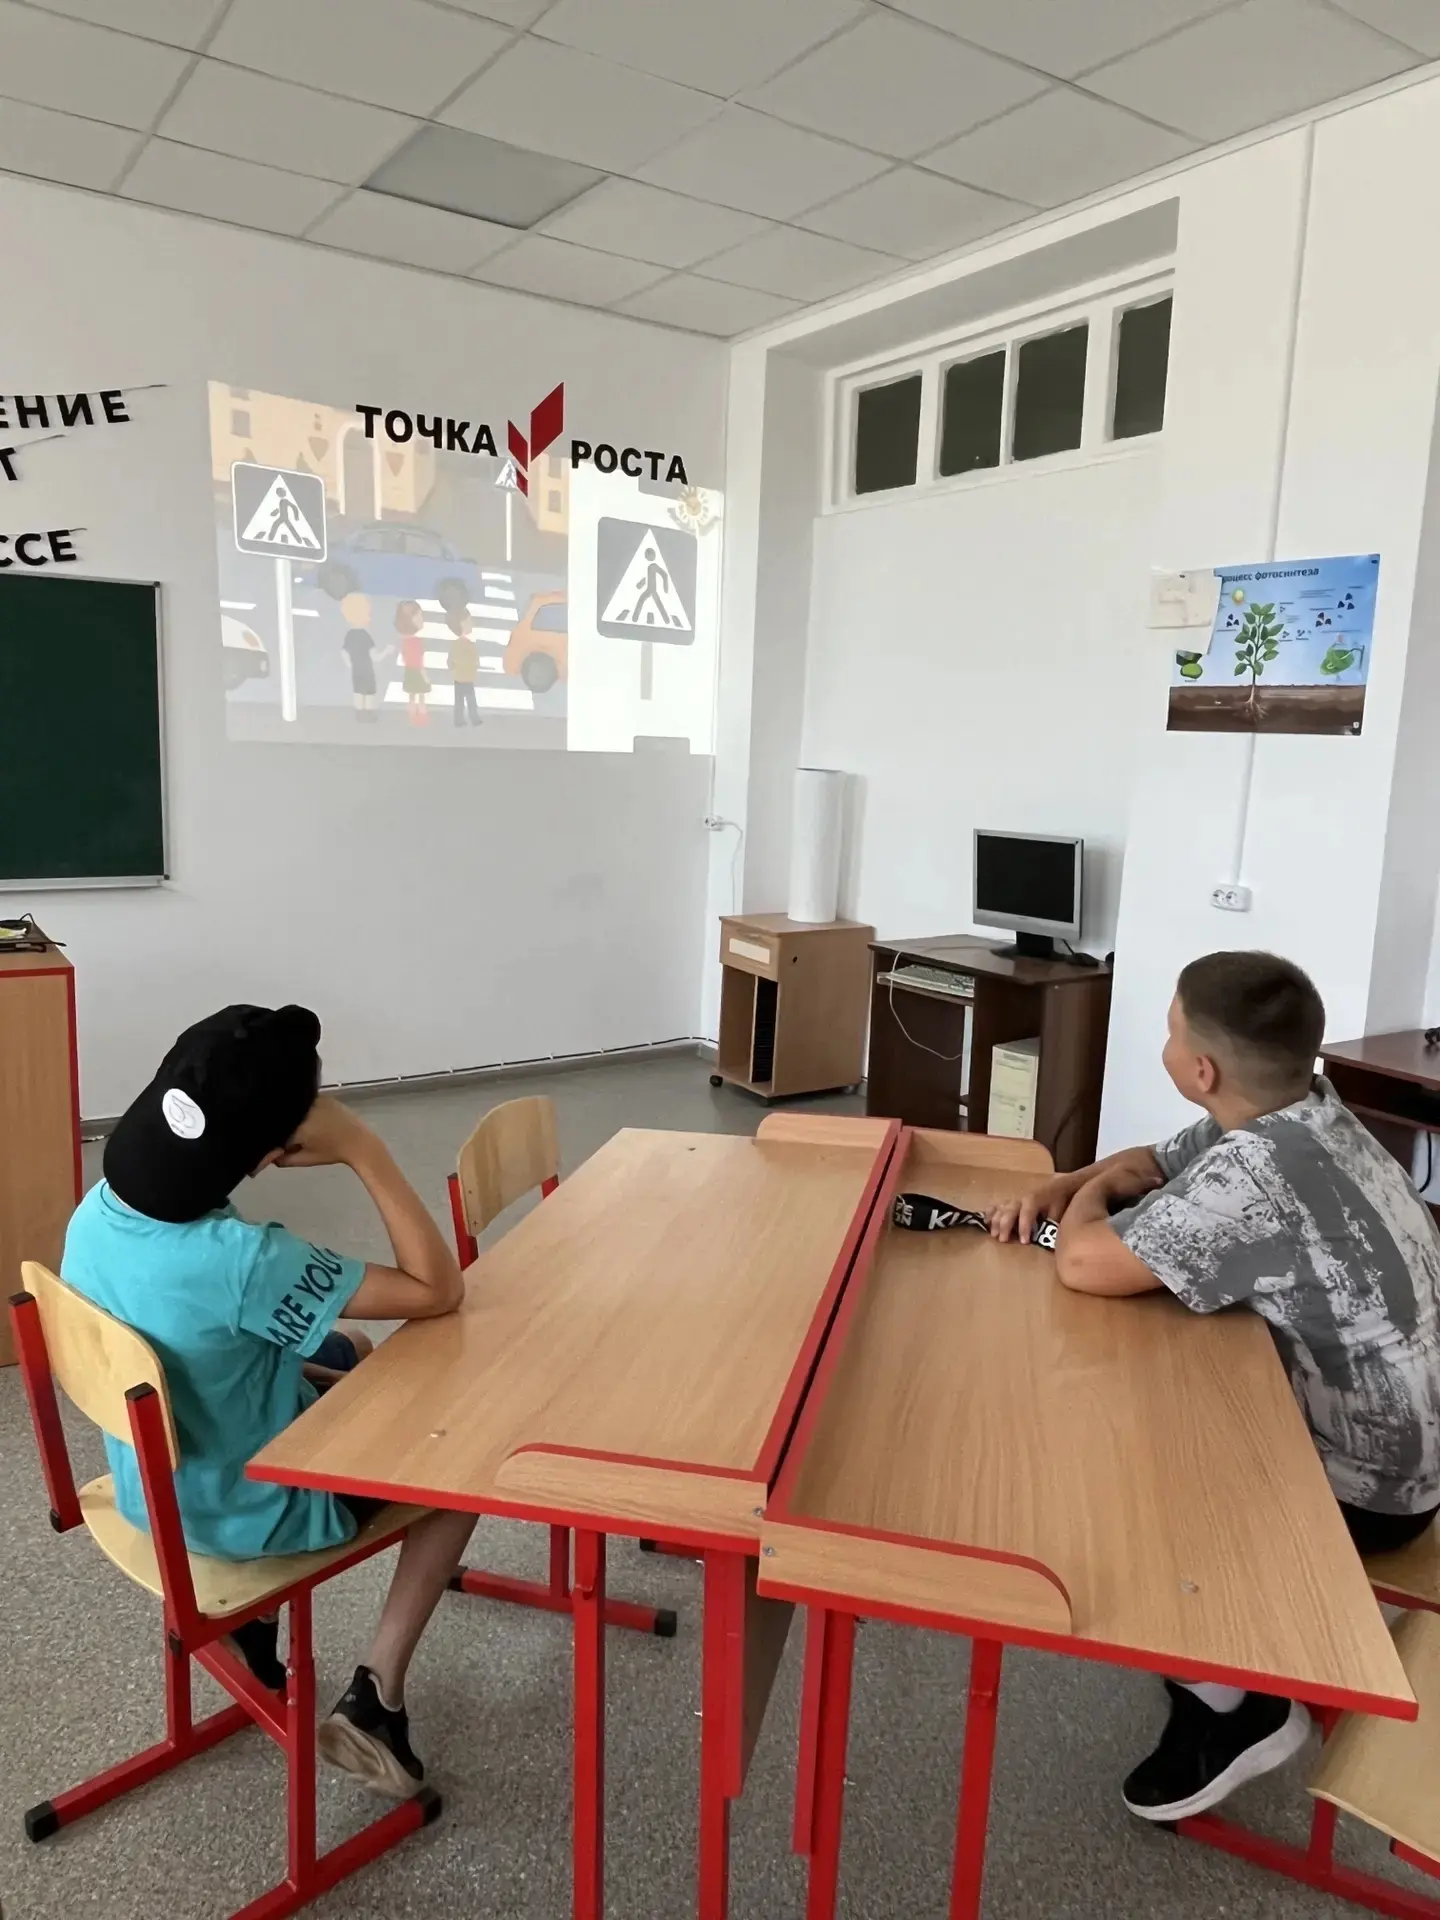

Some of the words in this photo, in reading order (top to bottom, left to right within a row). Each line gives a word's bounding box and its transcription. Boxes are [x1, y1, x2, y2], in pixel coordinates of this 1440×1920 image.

[355, 404, 498, 457] ТОЧКА
[571, 440, 688, 485] РОСТА
[265, 1293, 316, 1346] ARE
[293, 1242, 343, 1302] YOU
